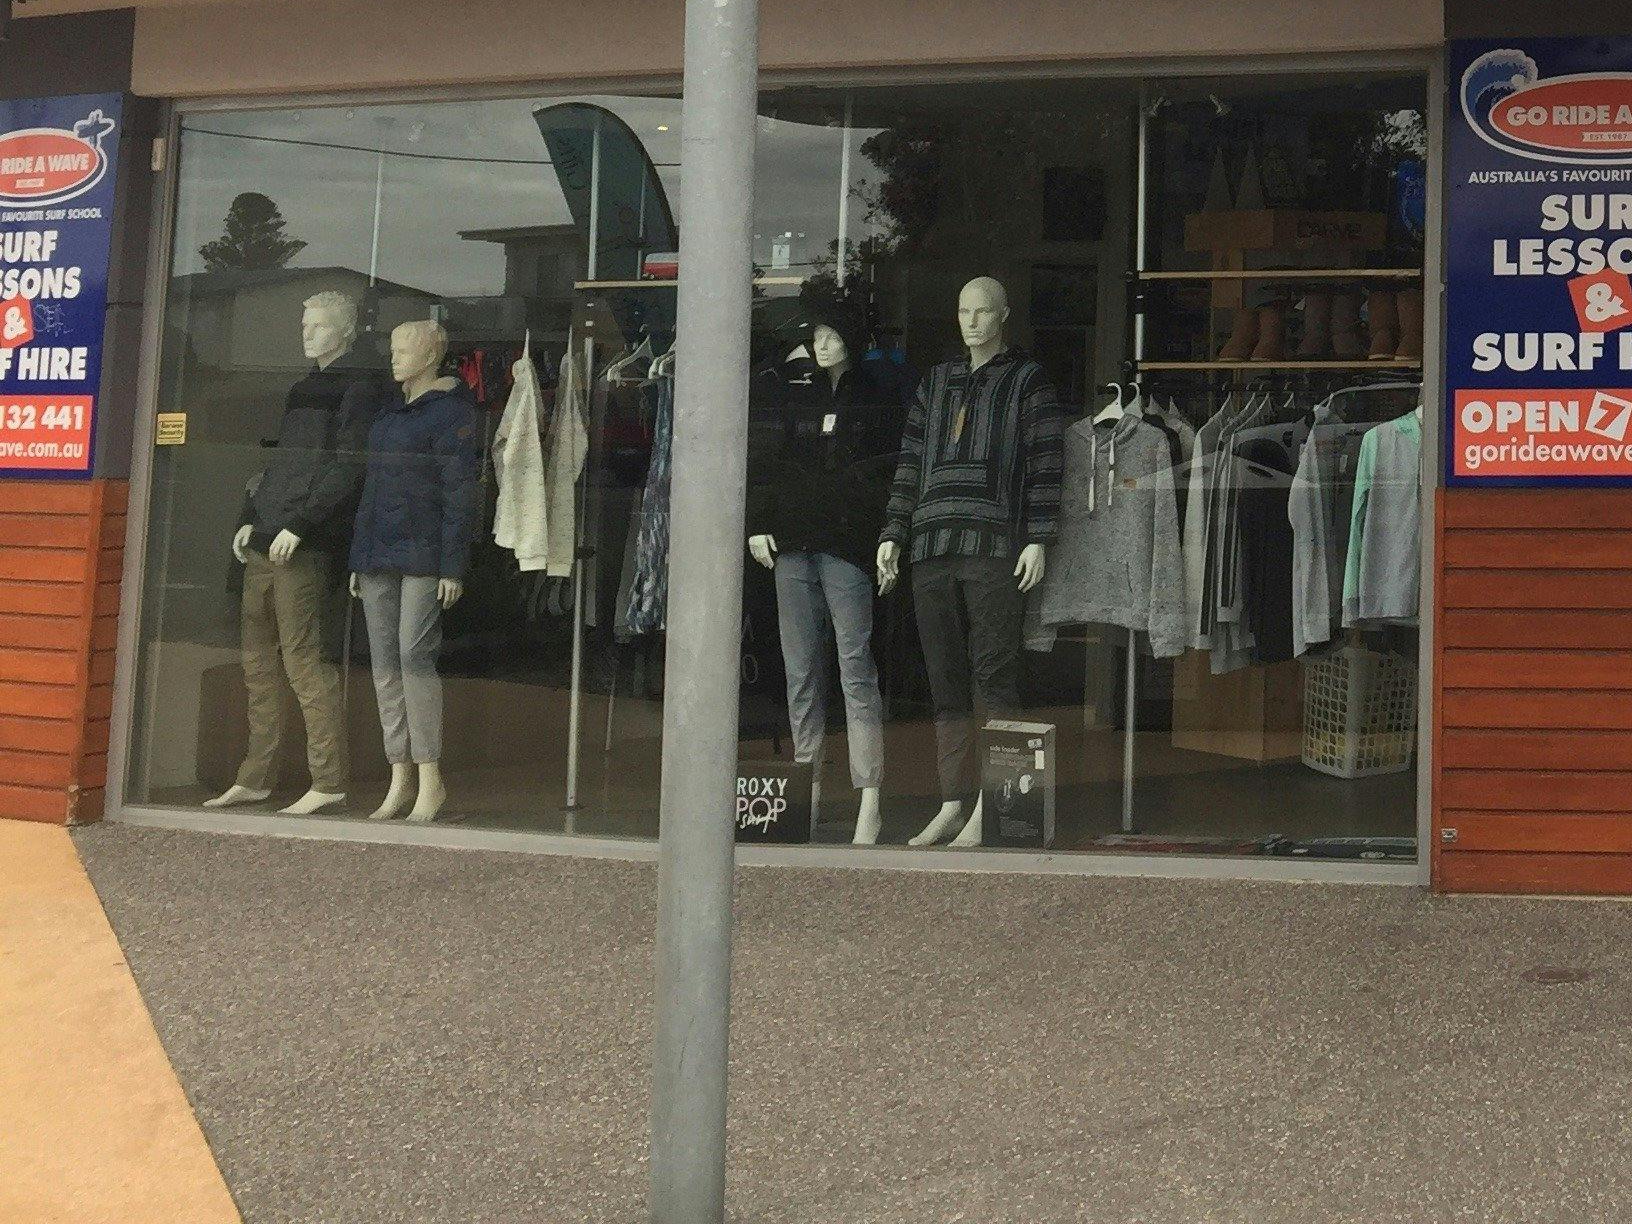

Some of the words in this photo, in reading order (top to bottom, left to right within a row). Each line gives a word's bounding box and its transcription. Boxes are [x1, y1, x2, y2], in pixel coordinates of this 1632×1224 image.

[1506, 106, 1547, 126] GO
[1552, 105, 1611, 125] RIDE
[1, 157, 34, 175] RIDE
[34, 155, 45, 173] A
[48, 153, 90, 172] WAVE
[45, 208, 66, 221] SURF
[67, 207, 102, 220] SCHOOL
[1585, 282, 1630, 323] &
[4, 306, 28, 341] &
[17, 347, 88, 381] HIRE
[1472, 332, 1605, 372] SURF
[41, 405, 84, 431] 441
[1461, 400, 1580, 434] OPEN
[1594, 399, 1627, 432] 7
[737, 777, 788, 796] ROXY
[736, 796, 787, 822] POP
